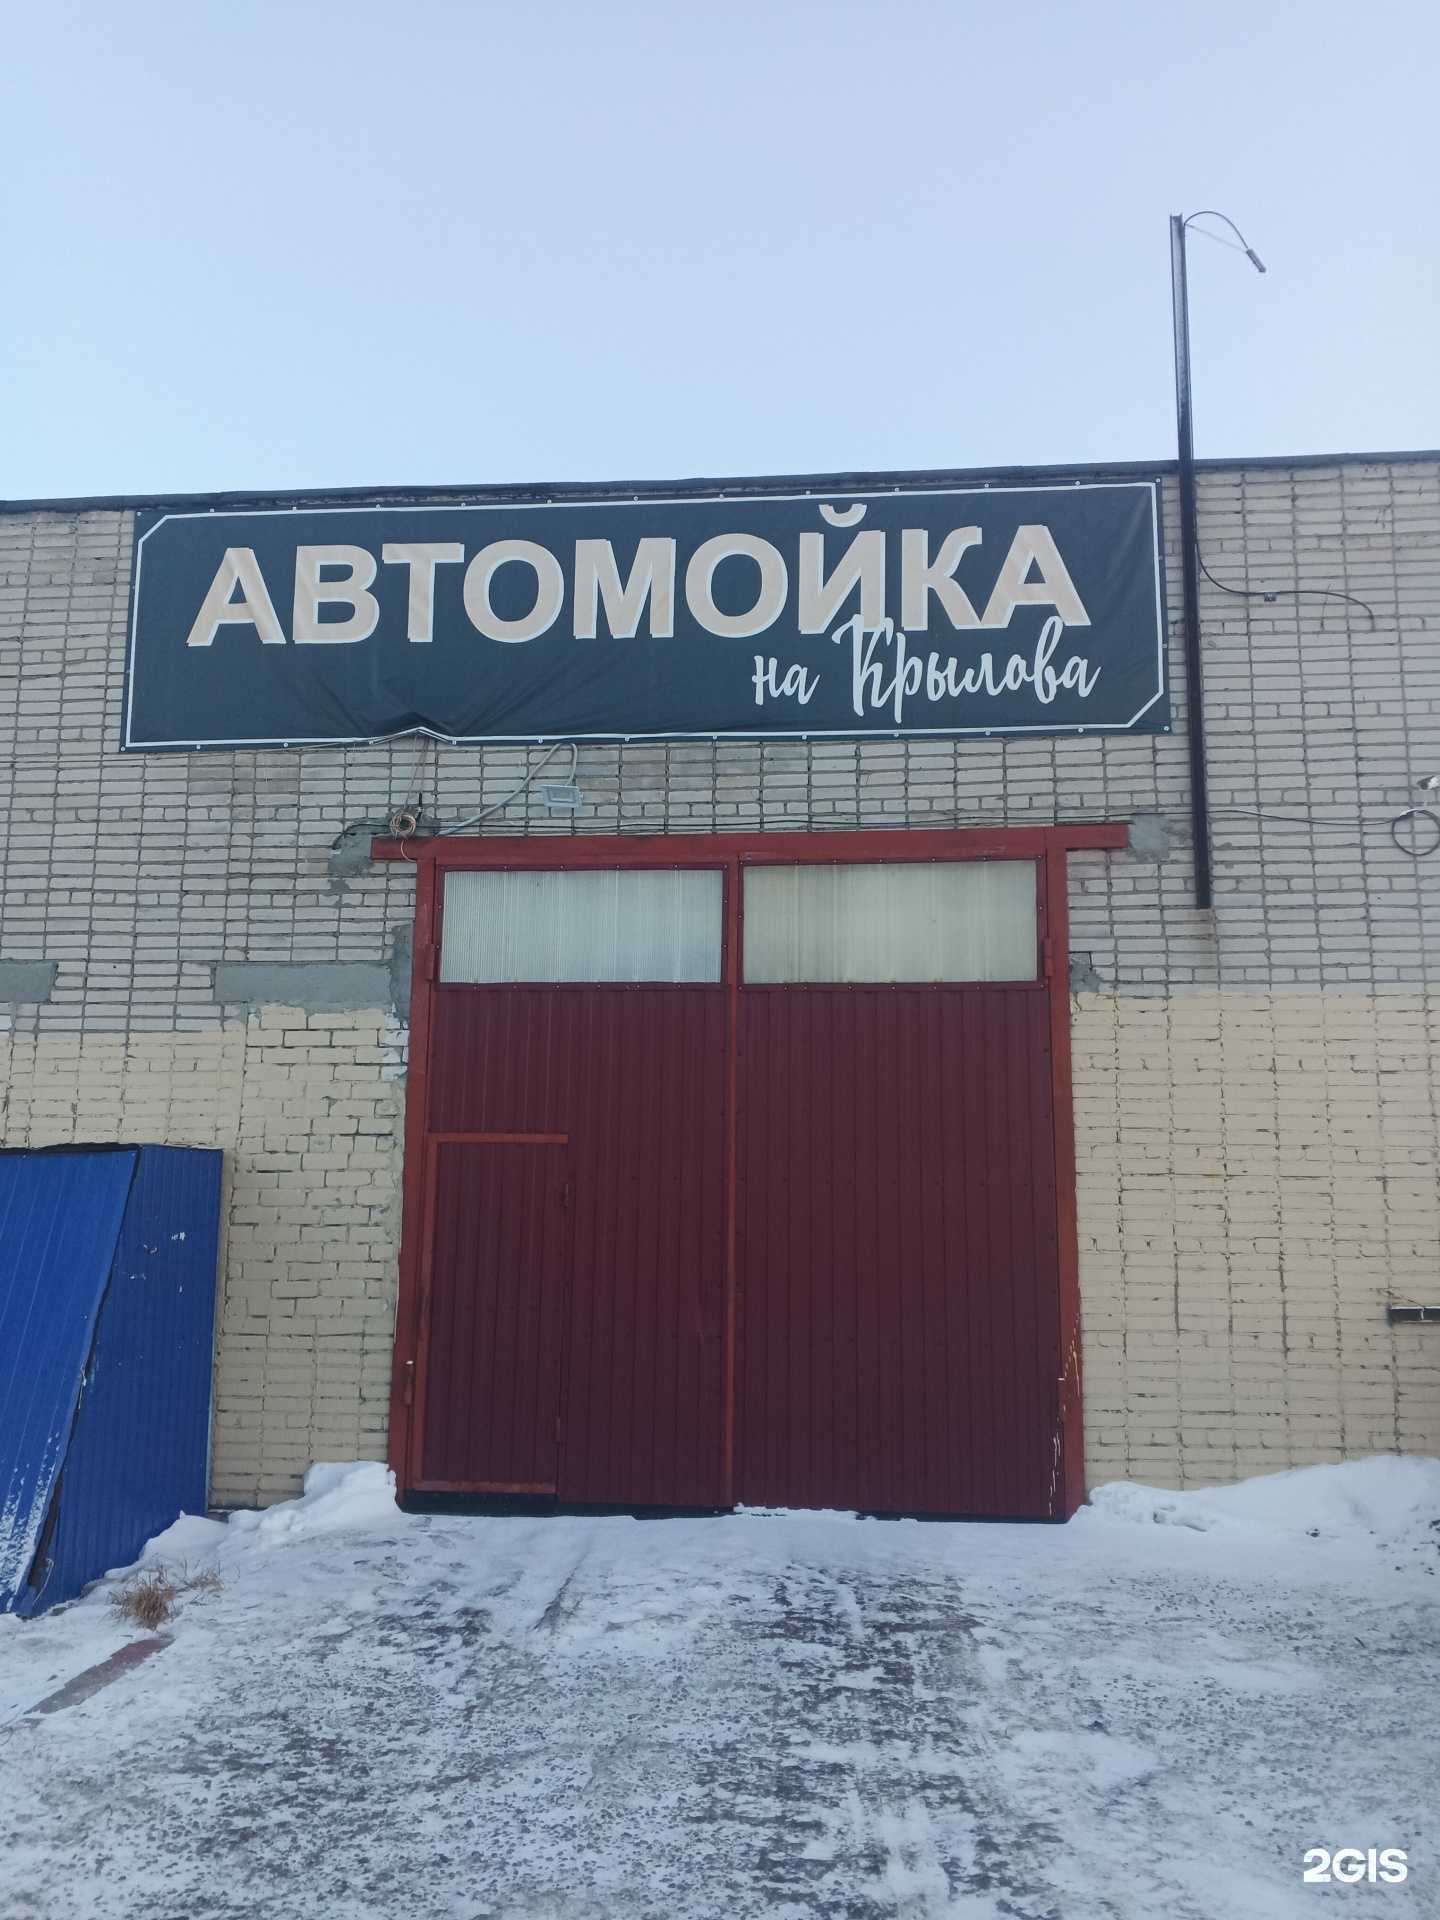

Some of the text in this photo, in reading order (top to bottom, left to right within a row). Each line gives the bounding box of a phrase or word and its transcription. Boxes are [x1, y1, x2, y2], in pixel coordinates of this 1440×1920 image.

[186, 503, 1092, 647] АВТОМОЙКА
[752, 614, 1101, 724] на Крылова
